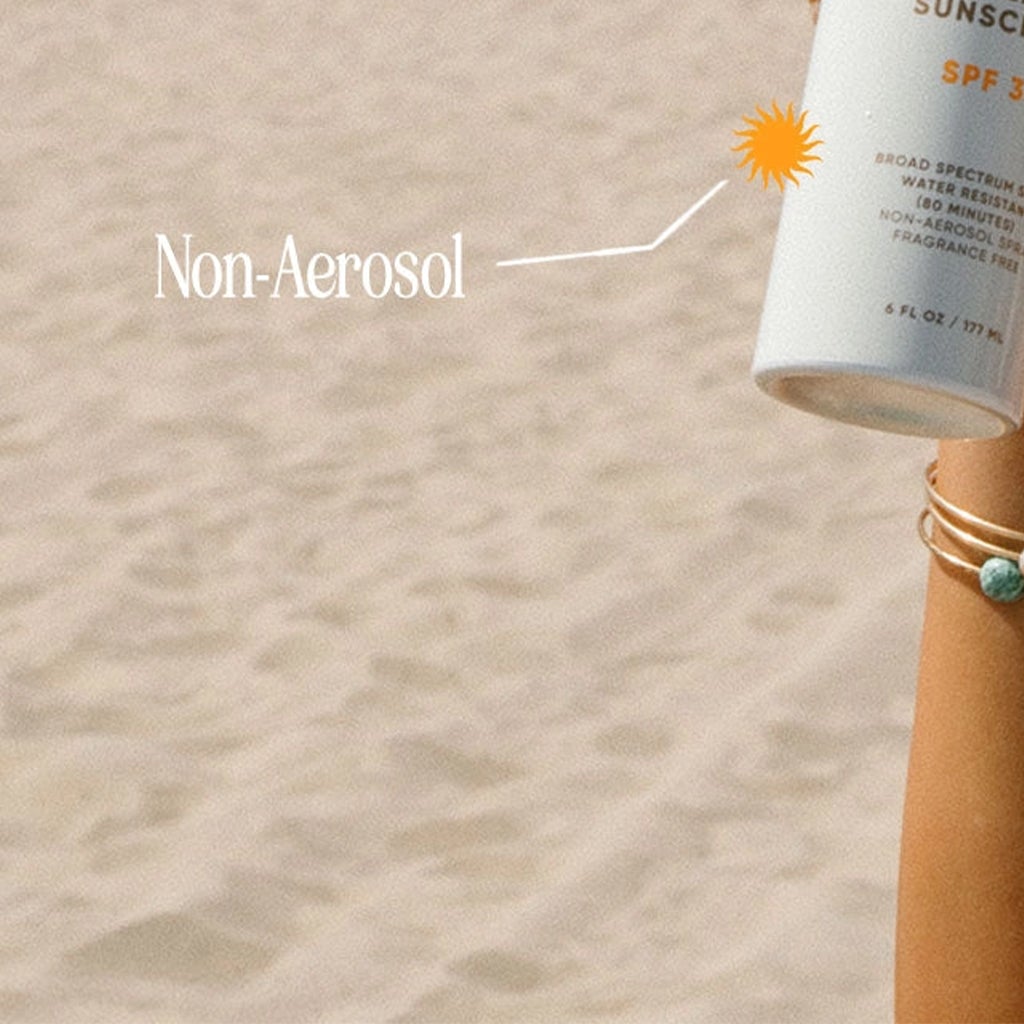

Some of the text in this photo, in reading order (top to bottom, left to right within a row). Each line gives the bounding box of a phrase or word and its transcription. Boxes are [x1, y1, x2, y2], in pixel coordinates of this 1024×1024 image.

[941, 58, 1000, 93] SPF
[874, 151, 931, 172] BROAD
[935, 161, 1015, 194] SPECTRUM
[901, 175, 956, 196] WATER
[878, 208, 994, 246] NON-AEROSOL
[916, 194, 1016, 234] (80 MINUTES)
[892, 228, 1020, 275] FRAGRANCE FREE
[884, 302, 894, 315] 6
[899, 304, 917, 320] FL
[922, 309, 945, 326] OZ
[948, 315, 959, 330] /
[962, 319, 985, 336] 177
